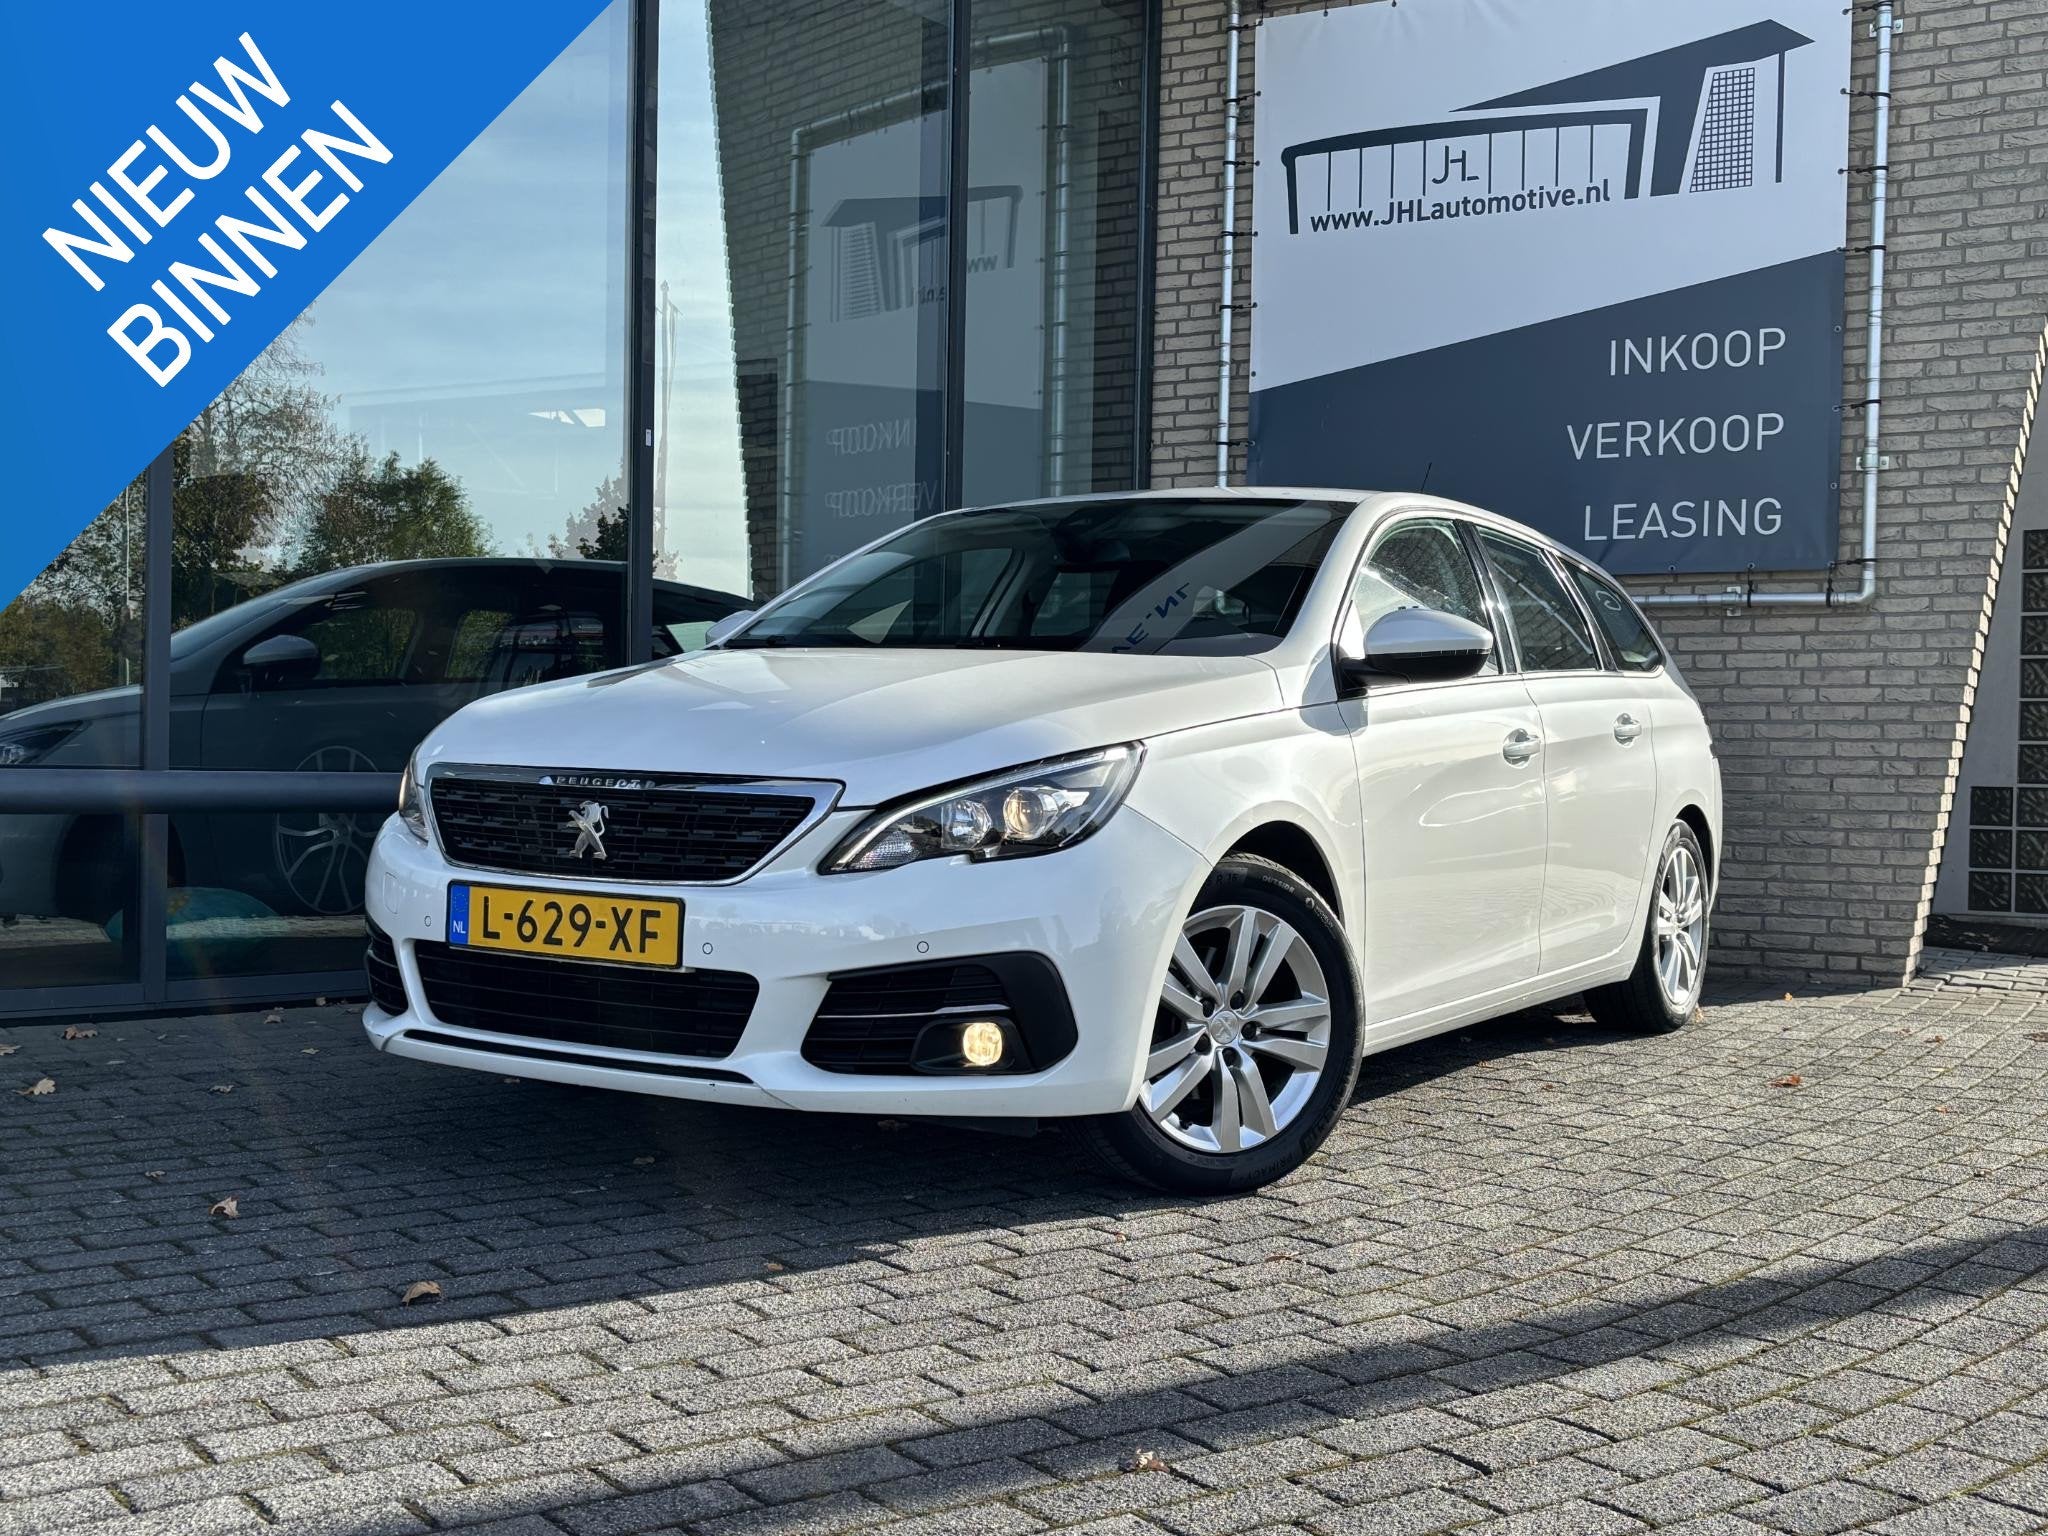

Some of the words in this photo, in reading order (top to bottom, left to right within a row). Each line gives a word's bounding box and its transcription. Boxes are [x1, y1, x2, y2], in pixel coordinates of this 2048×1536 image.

[1310, 179, 1610, 233] www.JHLautomotive.nl
[1609, 328, 1787, 376] INKOOP
[1567, 412, 1784, 460] VERKOOP
[1584, 497, 1782, 541] LEASING
[556, 776, 641, 788] PEUGEOT
[453, 920, 467, 934] NL
[482, 895, 662, 954] L-629-XF
